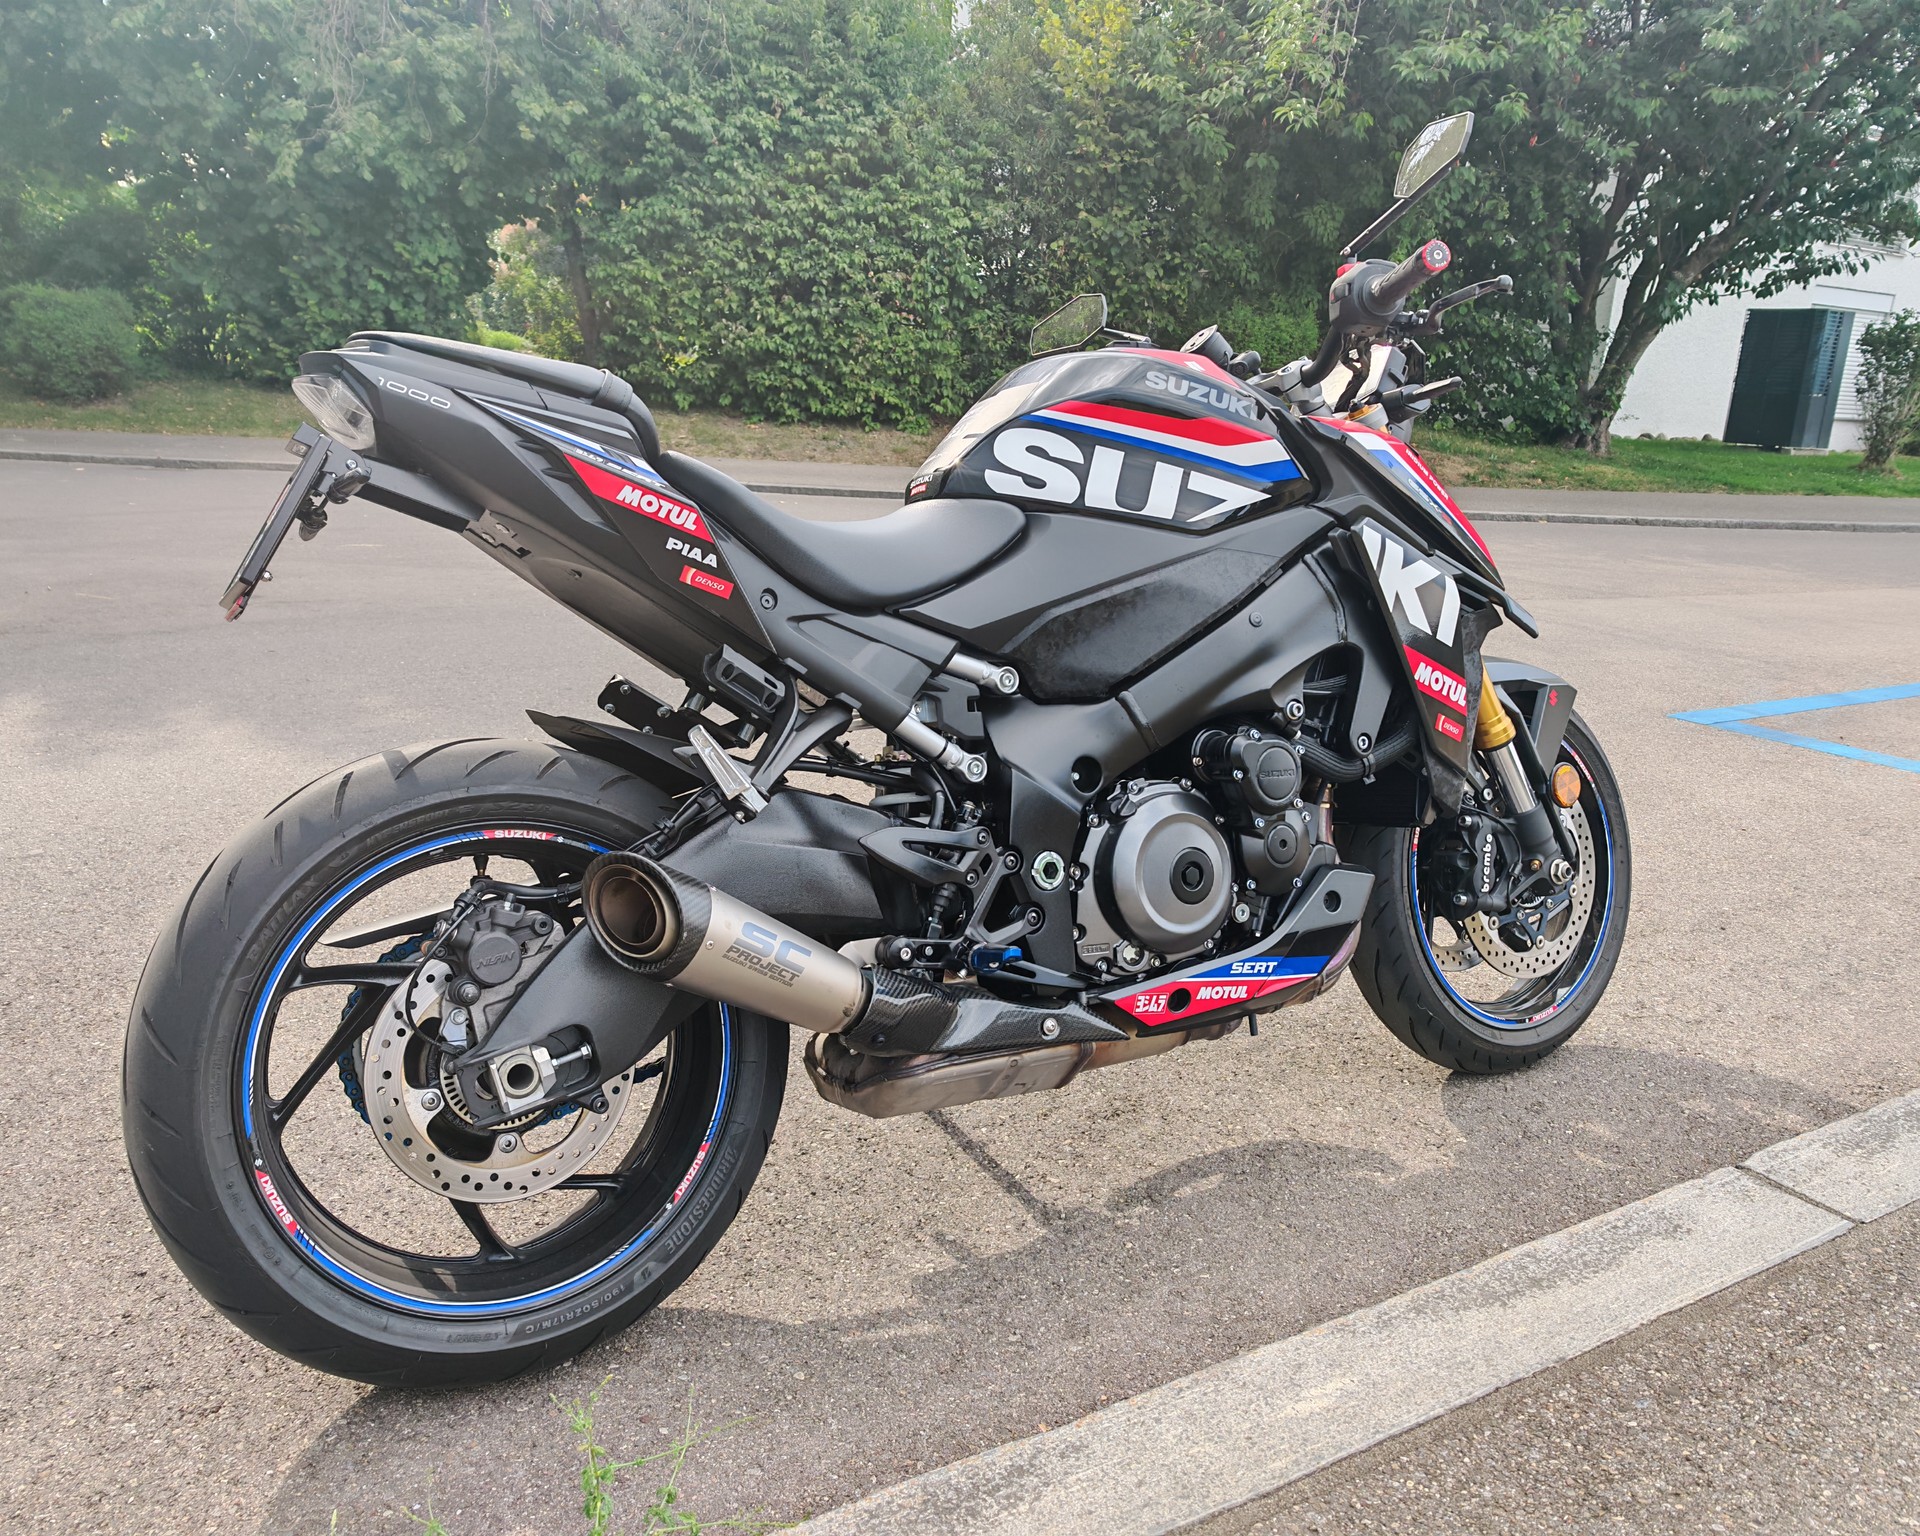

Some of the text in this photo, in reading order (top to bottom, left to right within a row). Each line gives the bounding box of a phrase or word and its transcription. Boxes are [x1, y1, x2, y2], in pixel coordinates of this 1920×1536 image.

[378, 376, 451, 409] 1000
[1144, 371, 1260, 421] SUZUKI
[910, 474, 934, 489] SUZUKI
[616, 484, 698, 531] MOTUL
[665, 537, 718, 568] PIAA
[695, 575, 725, 592] DENSO
[1414, 661, 1467, 708] MOTUL
[1442, 720, 1460, 736] DENSO
[1259, 768, 1296, 780] SUZUKI
[494, 829, 547, 841] SUZUKI
[1481, 833, 1494, 893] brembo
[726, 945, 800, 982] PROJECT
[733, 921, 813, 975] SC
[722, 953, 794, 988] SUZUKI SWISS EDITION
[1230, 961, 1278, 974] SERT
[1196, 985, 1248, 1000] MOTUL
[675, 1150, 706, 1197] SUZUKI
[260, 1175, 293, 1225] SUZUKI
[664, 1148, 741, 1255] BRIDGESTONE
